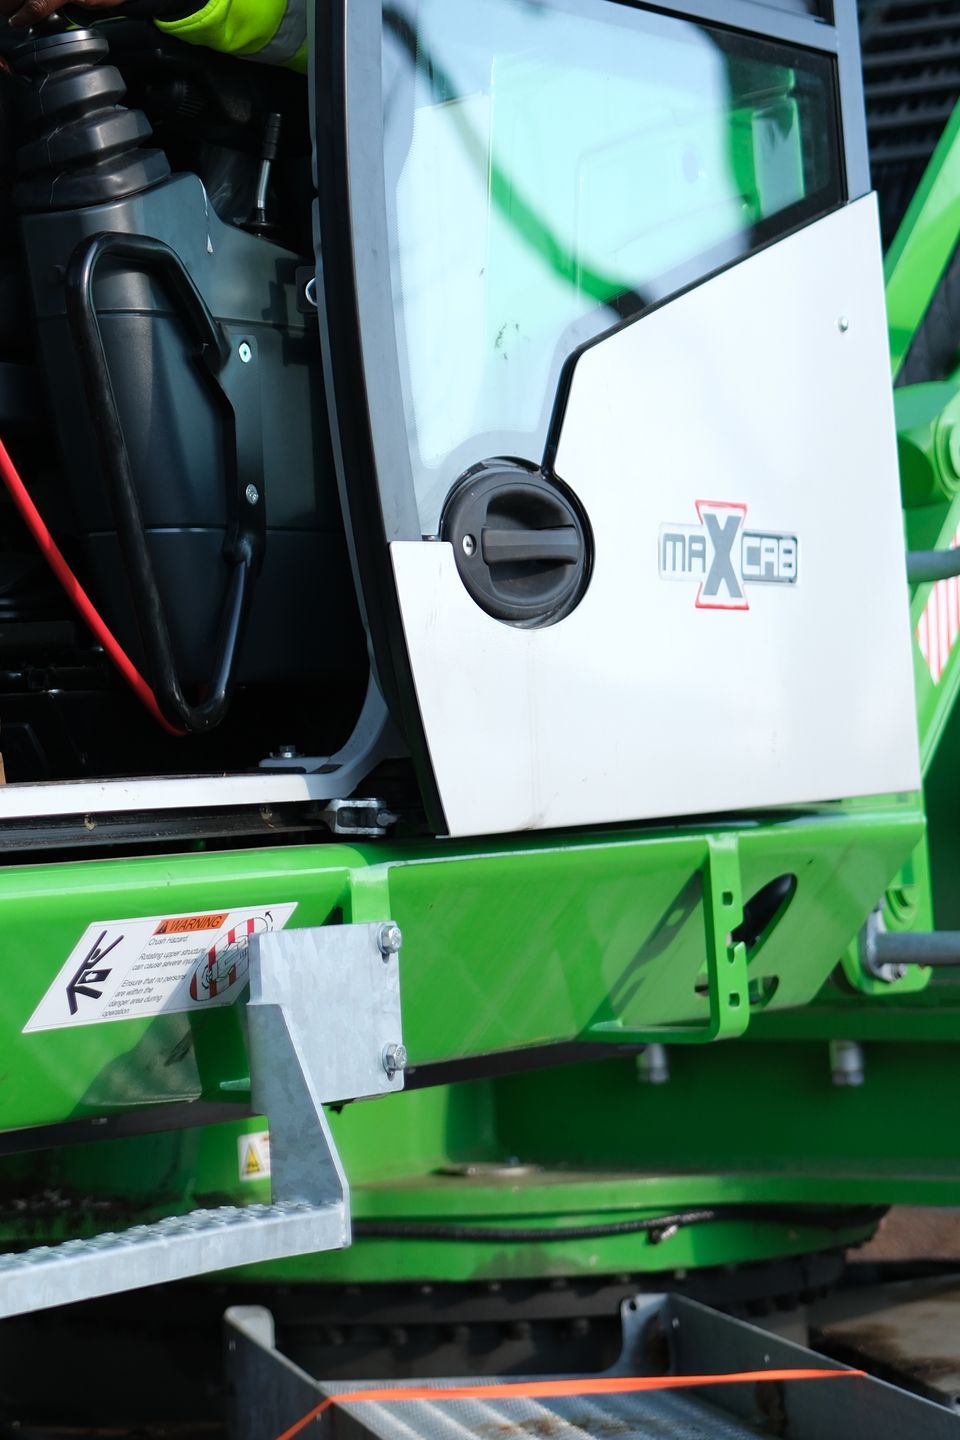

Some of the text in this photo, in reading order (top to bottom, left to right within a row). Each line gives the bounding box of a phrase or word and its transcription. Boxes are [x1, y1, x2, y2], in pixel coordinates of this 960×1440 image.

[169, 915, 222, 931] WARNING
[148, 937, 166, 946] Crush
[140, 947, 207, 961] Rotating upper structure
[132, 963, 144, 971] can
[144, 962, 162, 970] cause
[162, 960, 181, 968] severe
[121, 978, 144, 987] Ensure
[144, 977, 155, 985] that
[162, 974, 188, 984] persons
[126, 988, 143, 996] within
[143, 986, 154, 994] the
[109, 994, 163, 1008] danger area during
